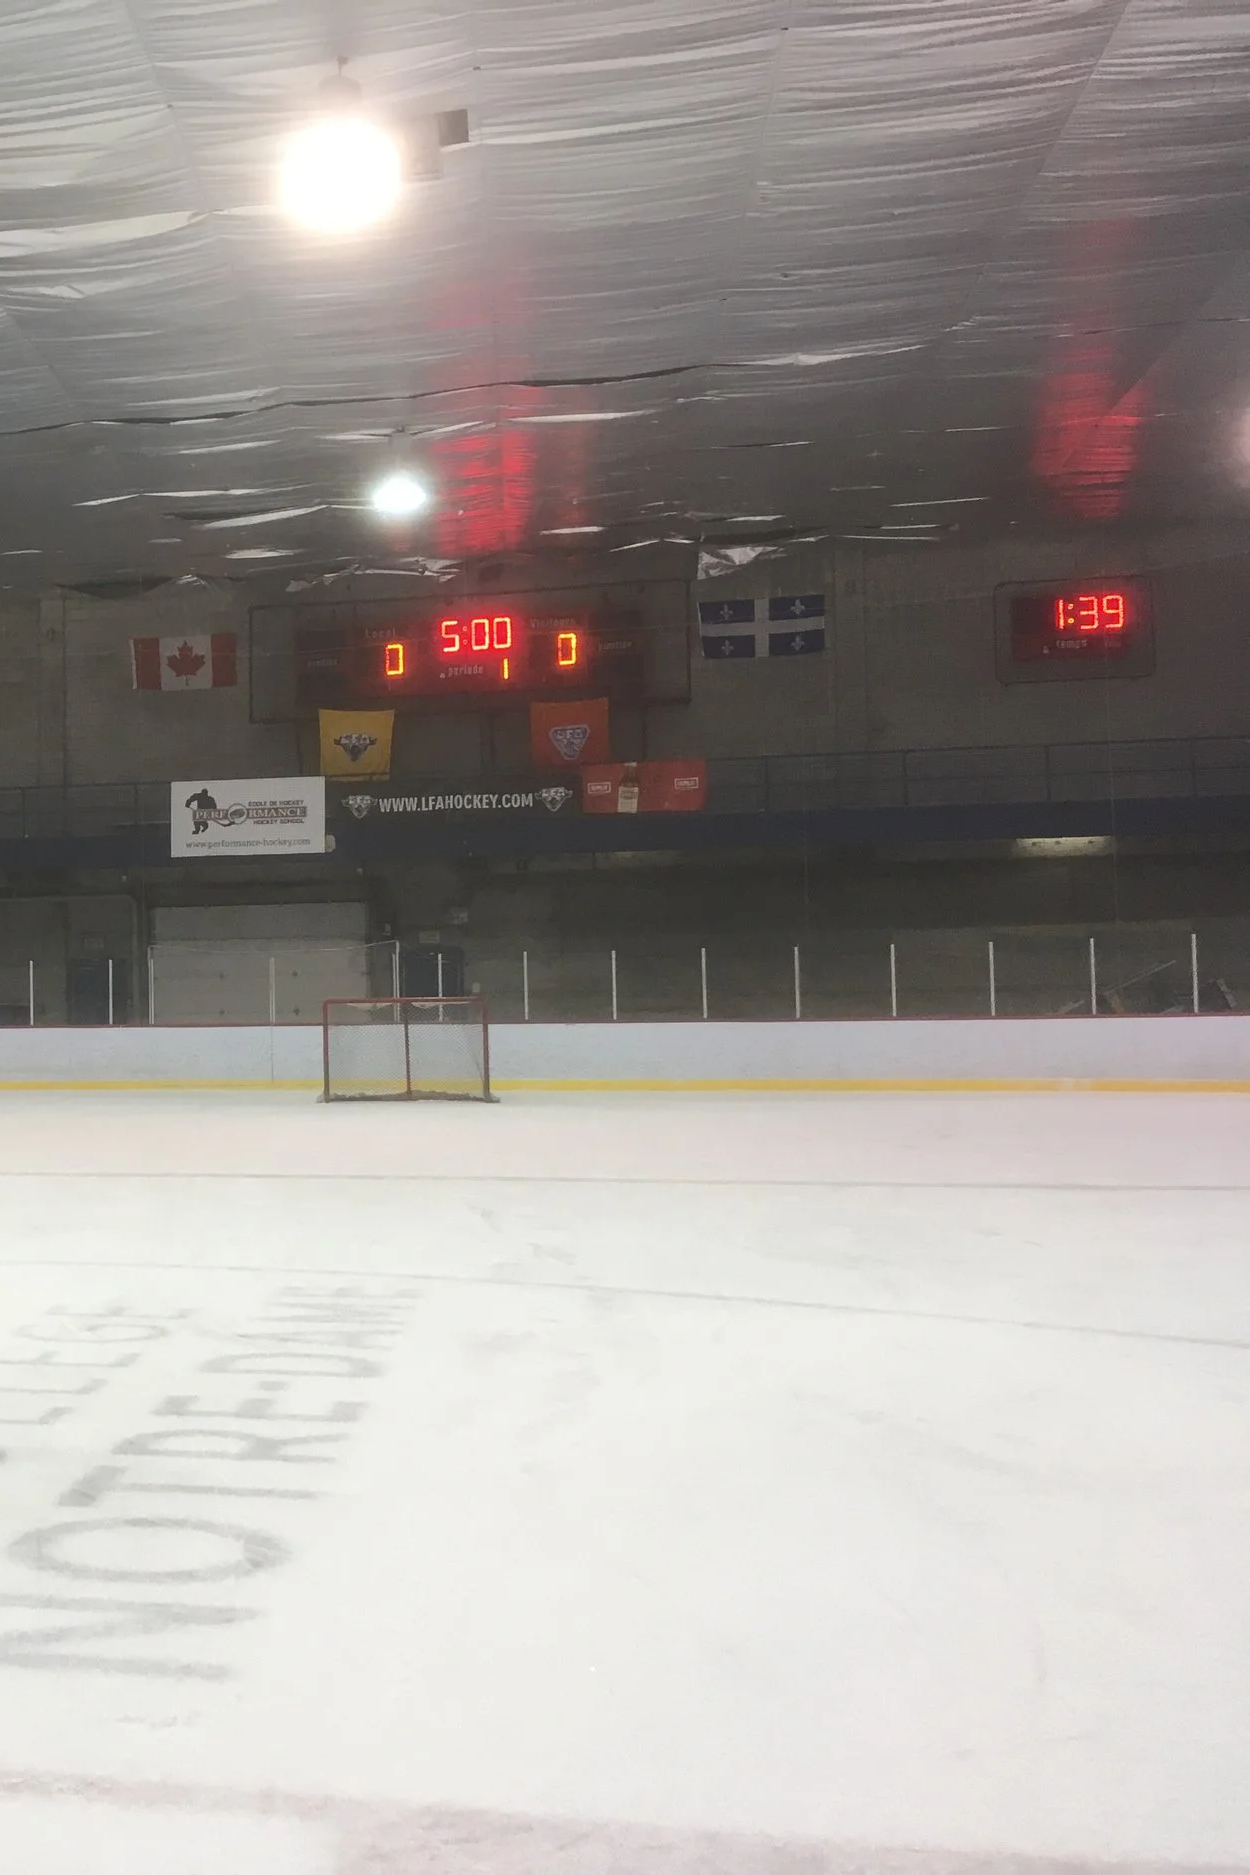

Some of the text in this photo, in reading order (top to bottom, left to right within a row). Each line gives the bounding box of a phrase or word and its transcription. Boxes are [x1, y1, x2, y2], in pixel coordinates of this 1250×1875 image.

[1057, 595, 1124, 630] 1:39
[441, 617, 512, 652] 5:00
[558, 632, 577, 666] 0
[385, 643, 404, 676] 0
[501, 658, 510, 680] 1
[378, 793, 534, 813] WWW.LFAHOCKEY.COM
[186, 838, 311, 849] www.performance-hockey.com
